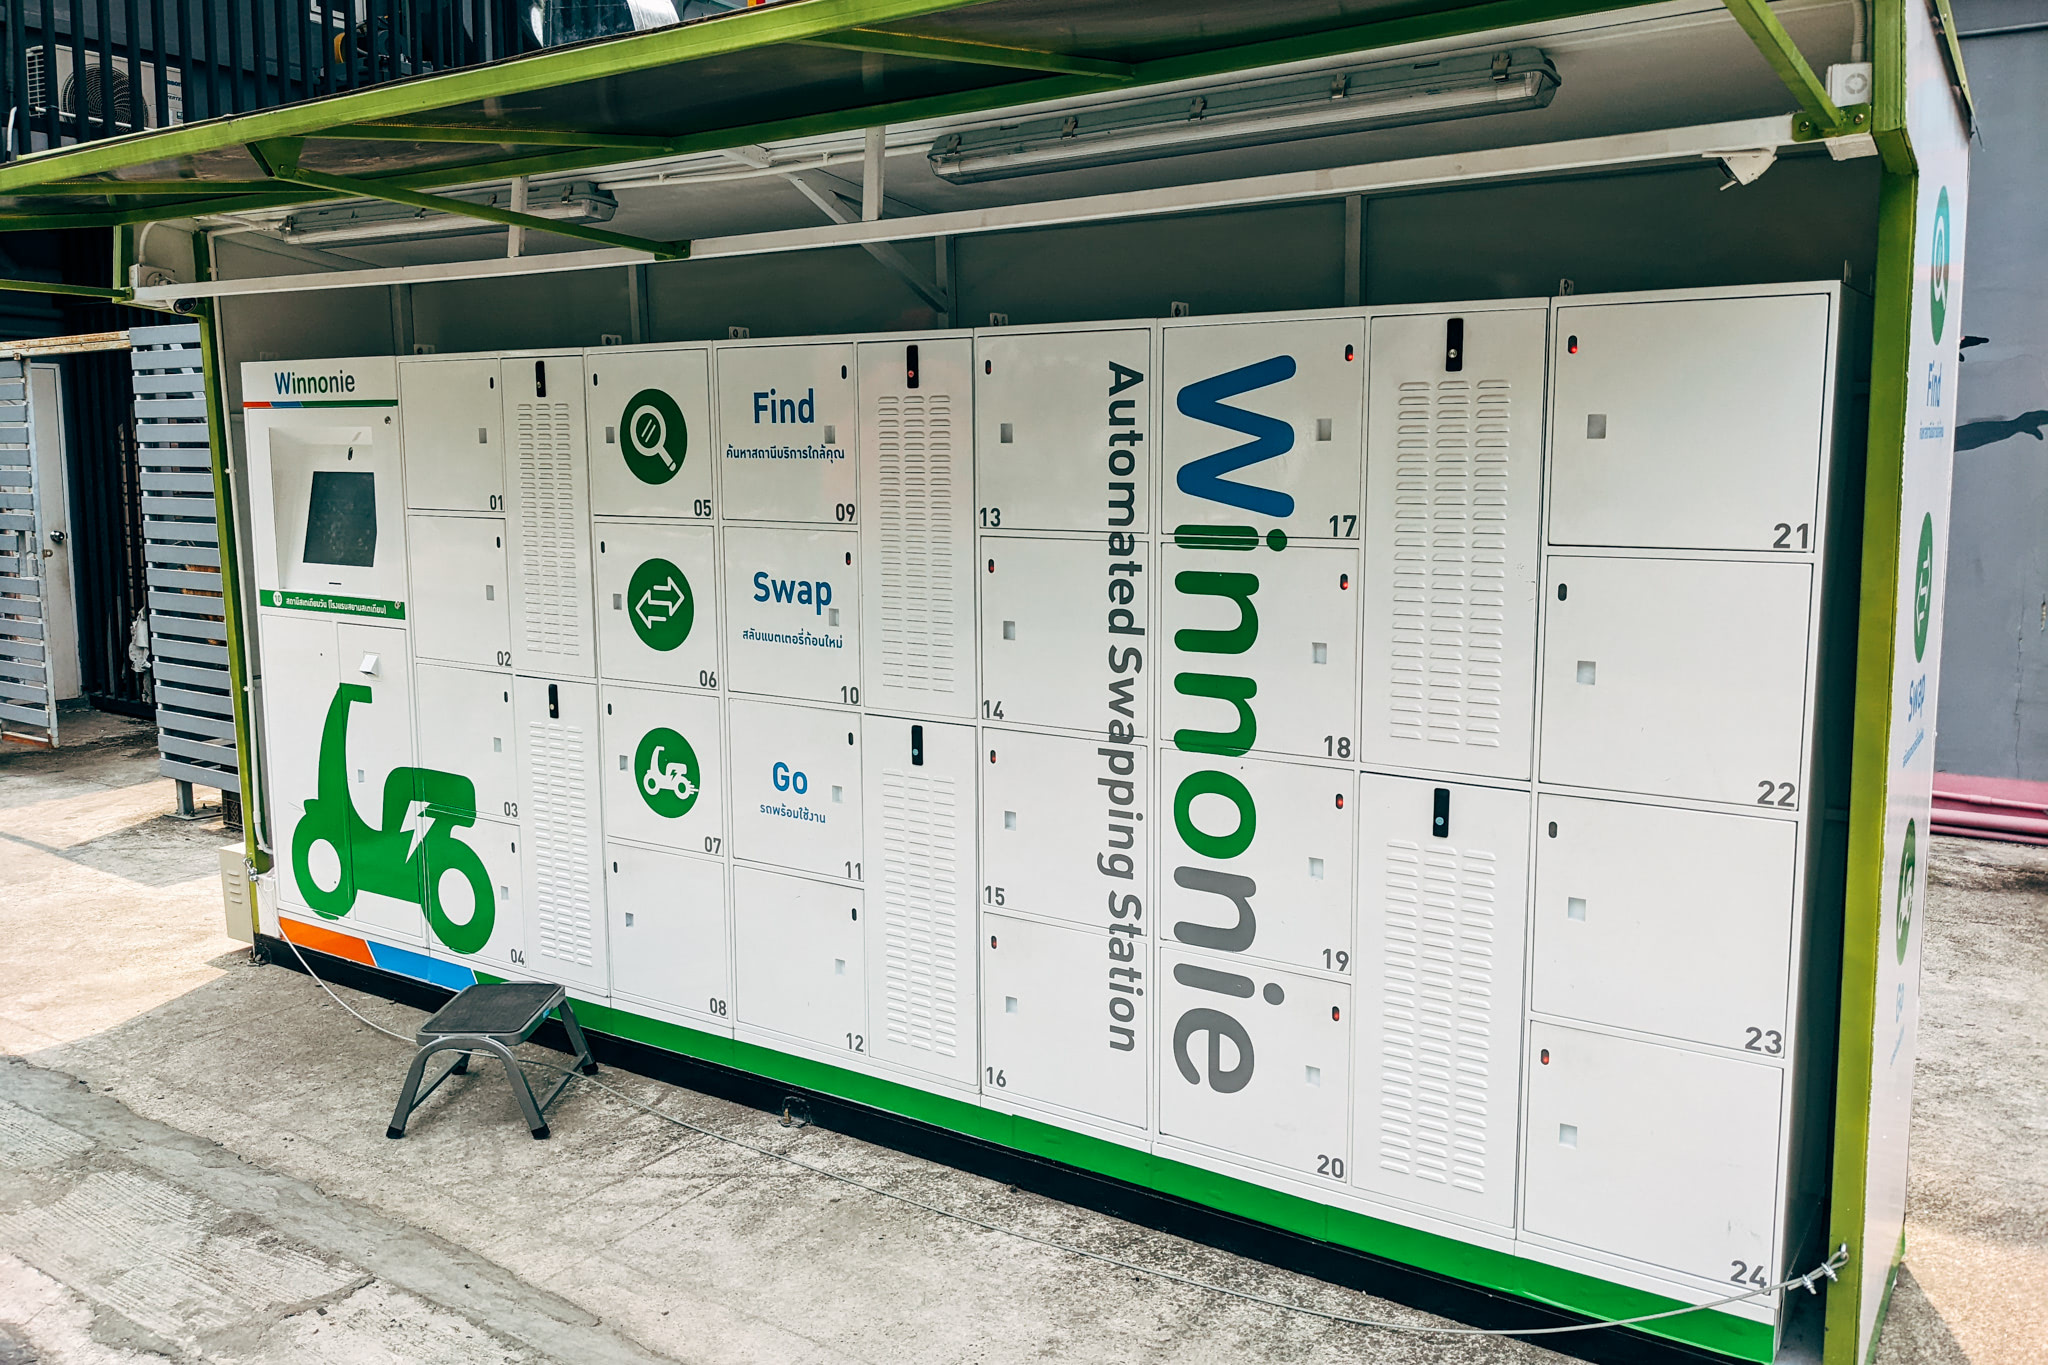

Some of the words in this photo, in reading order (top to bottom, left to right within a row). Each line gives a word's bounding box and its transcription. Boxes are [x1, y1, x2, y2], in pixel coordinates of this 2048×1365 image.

[275, 370, 355, 394] Winnonie
[754, 388, 814, 423] Find
[727, 443, 844, 463] ค้นหาสถานีบริการใกล้คุณ
[490, 495, 503, 511] 01
[694, 500, 711, 516] 05
[1108, 361, 1145, 635] Automated
[836, 504, 855, 521] 09
[980, 508, 1000, 528] 13
[1330, 515, 1356, 537] 17
[1773, 523, 1808, 548] 21
[754, 572, 832, 615] Swap
[743, 628, 842, 648] สลับแบตเตอรี่ก้อนใหม่
[497, 651, 512, 668] 02
[700, 670, 716, 687] 06
[841, 686, 859, 704] 10
[982, 699, 1004, 720] 14
[1174, 355, 1296, 1093] Winnonie
[1325, 736, 1350, 758] 18
[1097, 646, 1143, 879] Swapping
[773, 762, 807, 794] Go
[1757, 781, 1795, 806] 22
[504, 802, 518, 817] 03
[760, 803, 825, 823] รถพร้อมใช้งาน
[705, 837, 721, 855] 07
[845, 861, 861, 880] 11
[984, 886, 1004, 905] 15
[511, 949, 524, 965] 04
[1323, 949, 1349, 971] 19
[1109, 891, 1143, 1051] Station
[710, 998, 726, 1016] 08
[847, 1033, 864, 1052] 12
[1746, 1027, 1781, 1053] 23
[987, 1067, 1006, 1087] 16
[1317, 1155, 1343, 1178] 20
[1731, 1260, 1767, 1286] 24
